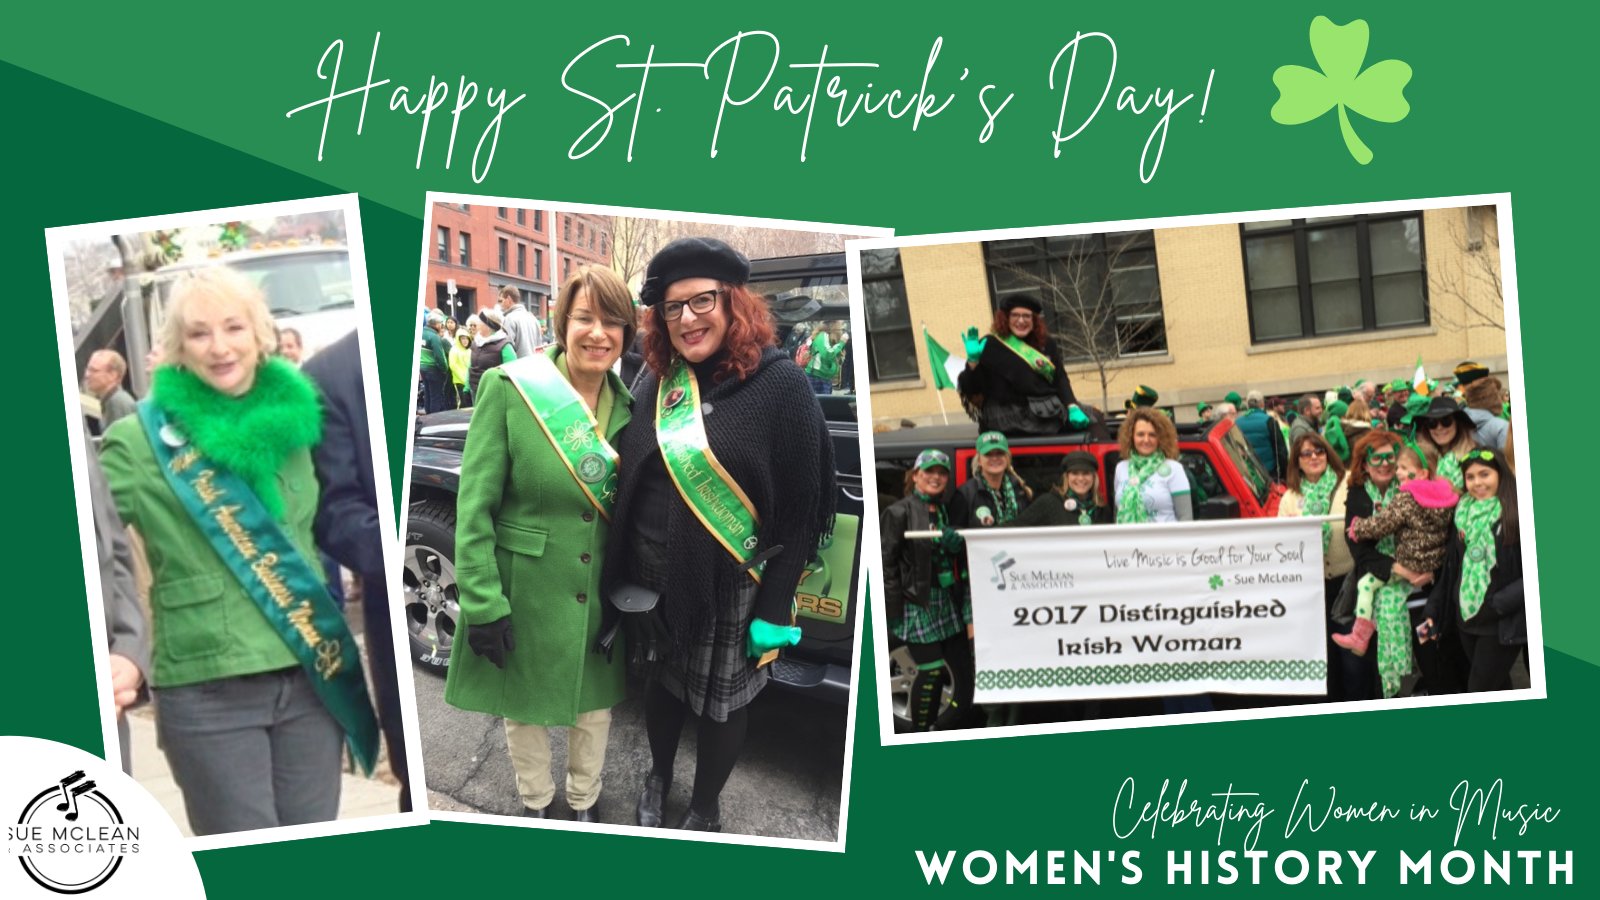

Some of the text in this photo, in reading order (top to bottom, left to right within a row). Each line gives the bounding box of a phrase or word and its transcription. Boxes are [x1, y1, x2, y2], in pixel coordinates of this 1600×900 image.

[1103, 540, 1305, 568] Live Music is Good for Your Soul
[1021, 581, 1075, 591] ASSOCIATES
[1234, 573, 1256, 585] Sue
[1257, 572, 1303, 584] McLean
[1012, 599, 1287, 627] 2017 Distinguished
[1056, 634, 1242, 656] Irish Woman
